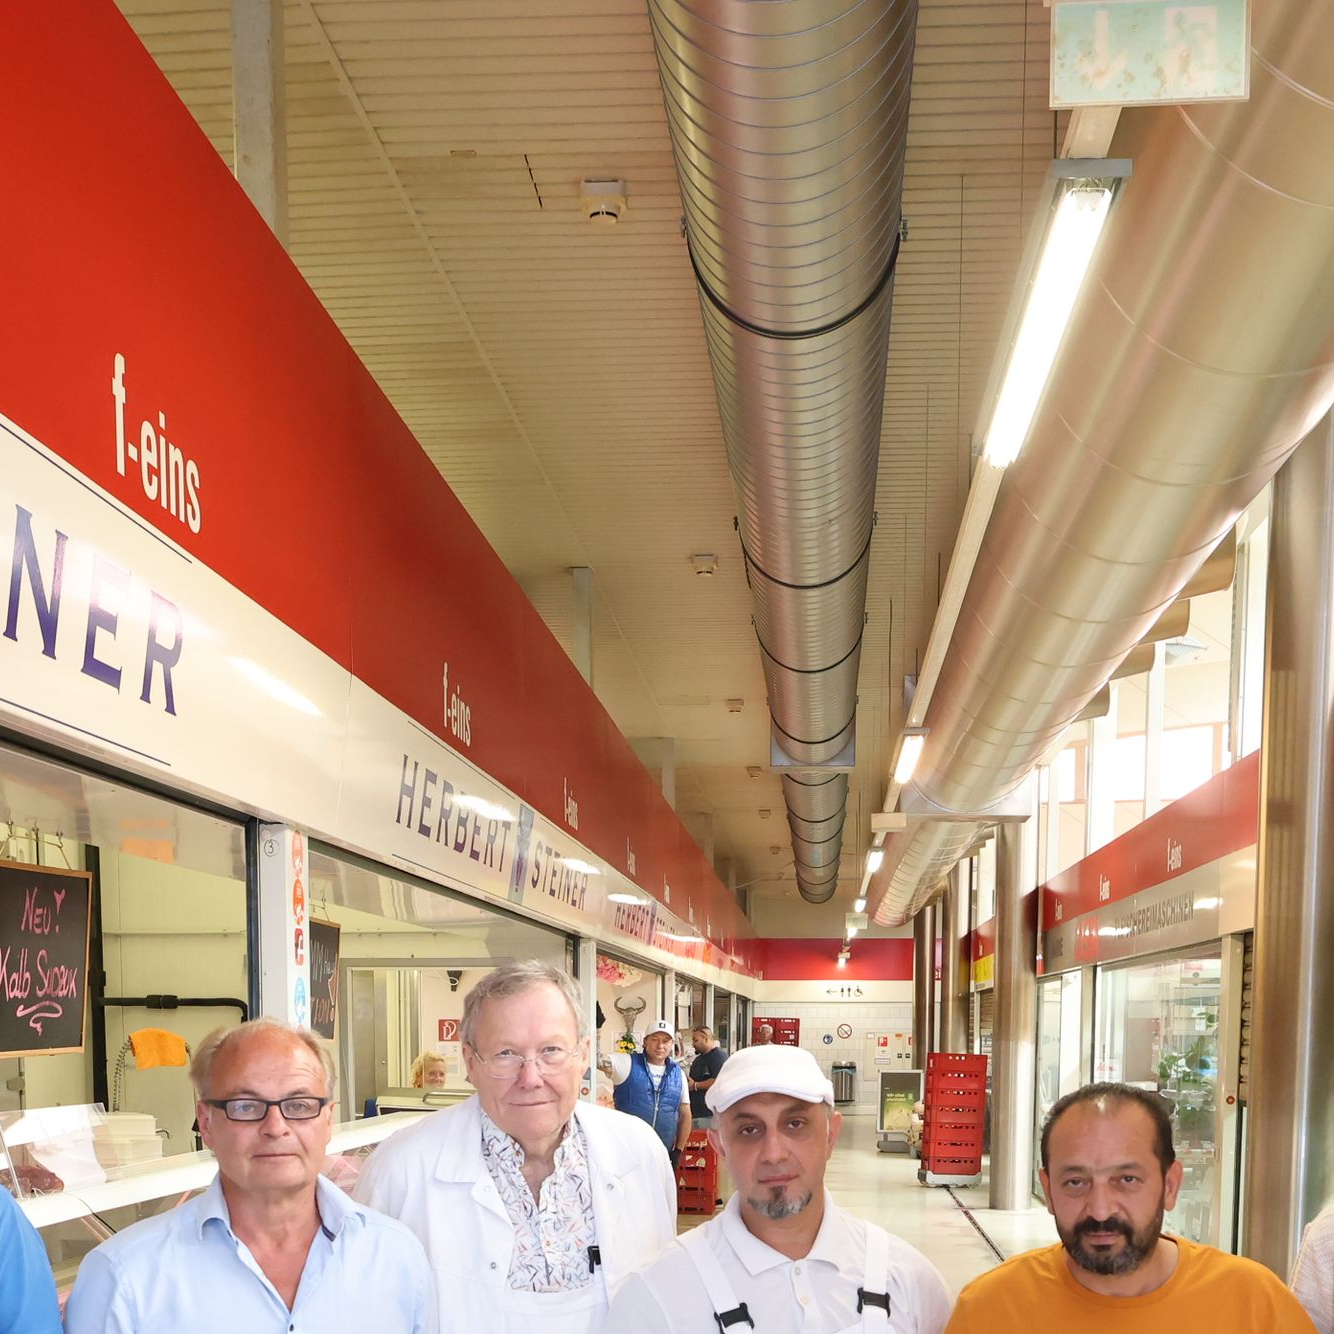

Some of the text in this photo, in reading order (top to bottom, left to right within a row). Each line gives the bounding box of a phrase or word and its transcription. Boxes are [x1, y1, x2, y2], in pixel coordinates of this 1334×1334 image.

[111, 353, 201, 534] f-eins
[442, 662, 472, 747] f-eins
[396, 754, 511, 872] HERBERT
[531, 840, 588, 911] STEINER
